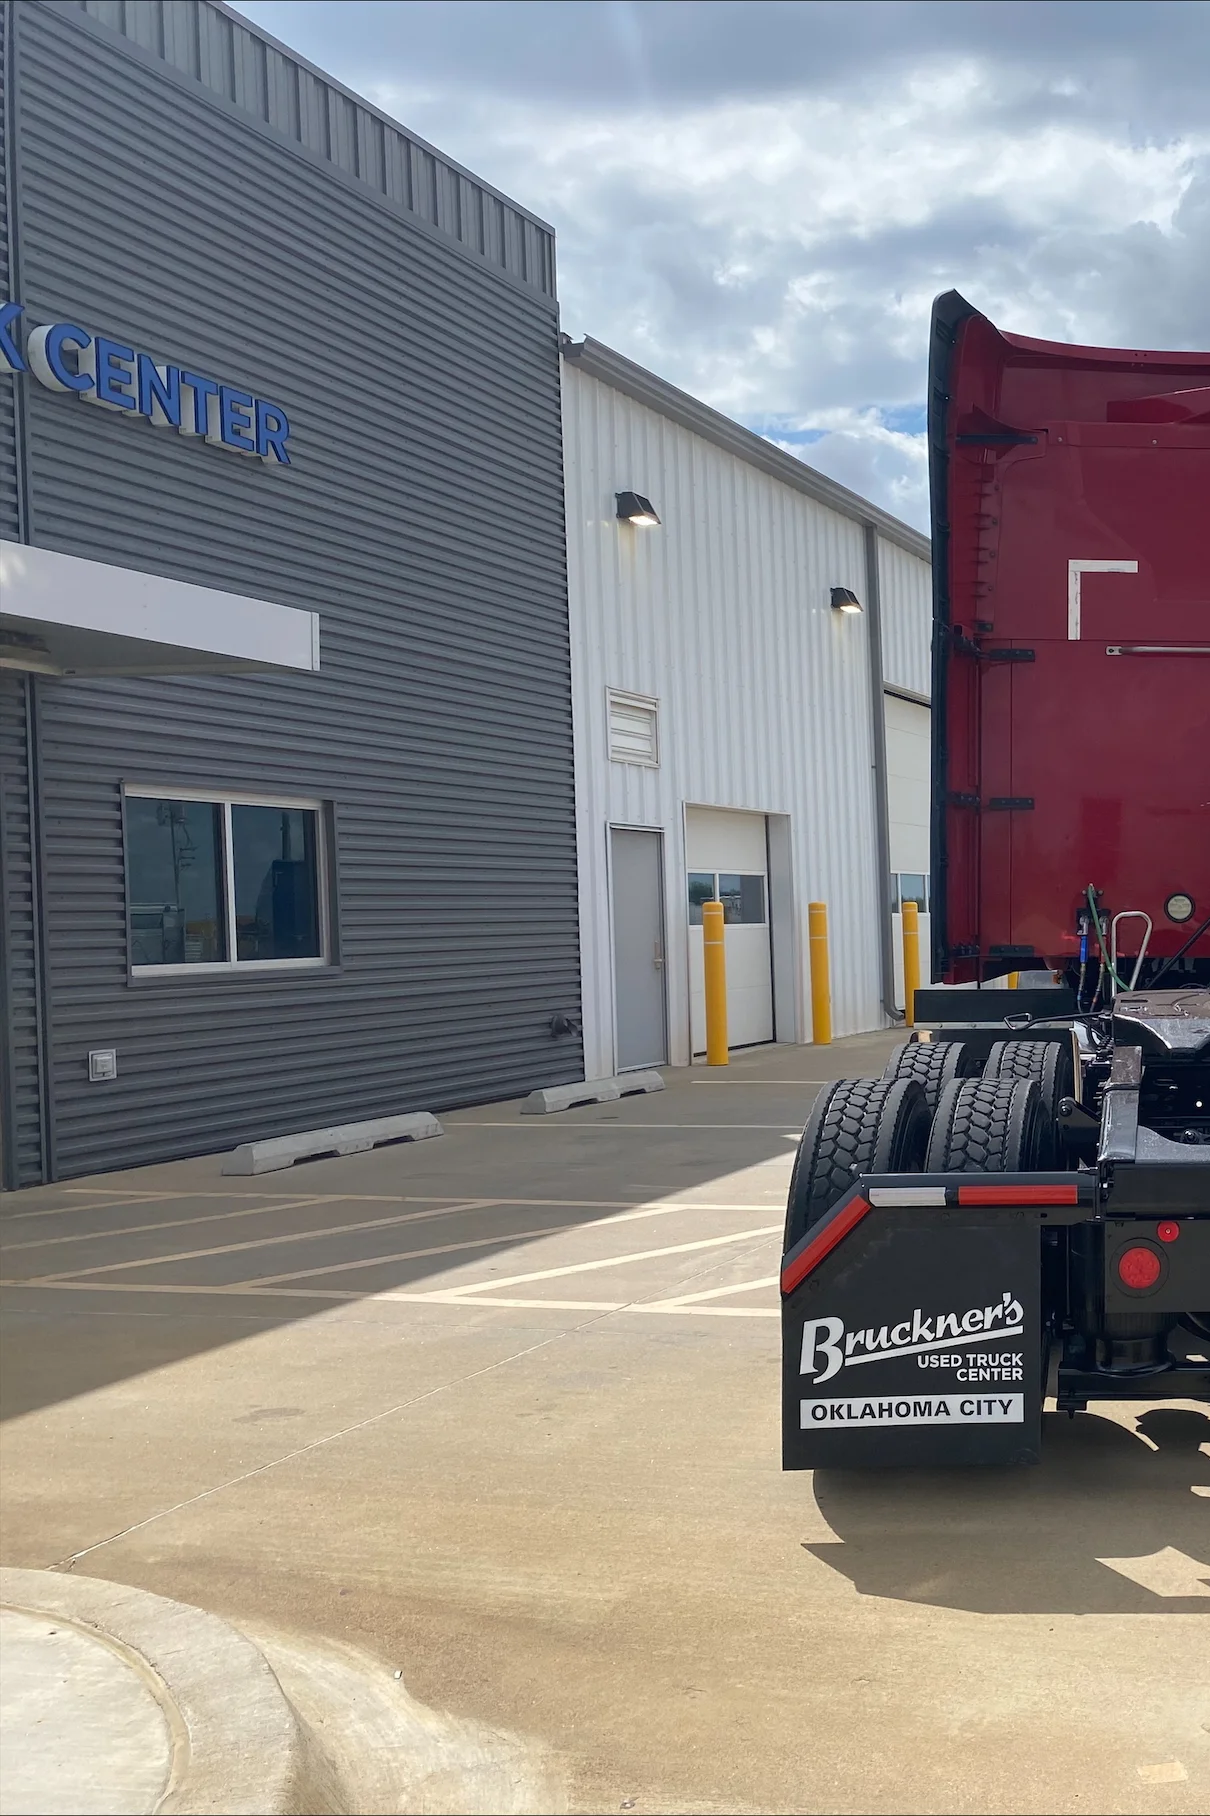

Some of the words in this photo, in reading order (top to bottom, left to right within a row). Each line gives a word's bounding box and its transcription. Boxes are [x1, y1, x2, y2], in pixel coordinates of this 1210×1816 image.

[44, 323, 292, 465] CENTER
[799, 1292, 1024, 1385] Bruckner's
[917, 1354, 962, 1369] USED
[965, 1352, 1024, 1367] TRUCK
[956, 1367, 1024, 1381] CENTER
[810, 1400, 951, 1421] OKLAHOMA
[959, 1399, 1014, 1416] CITY
